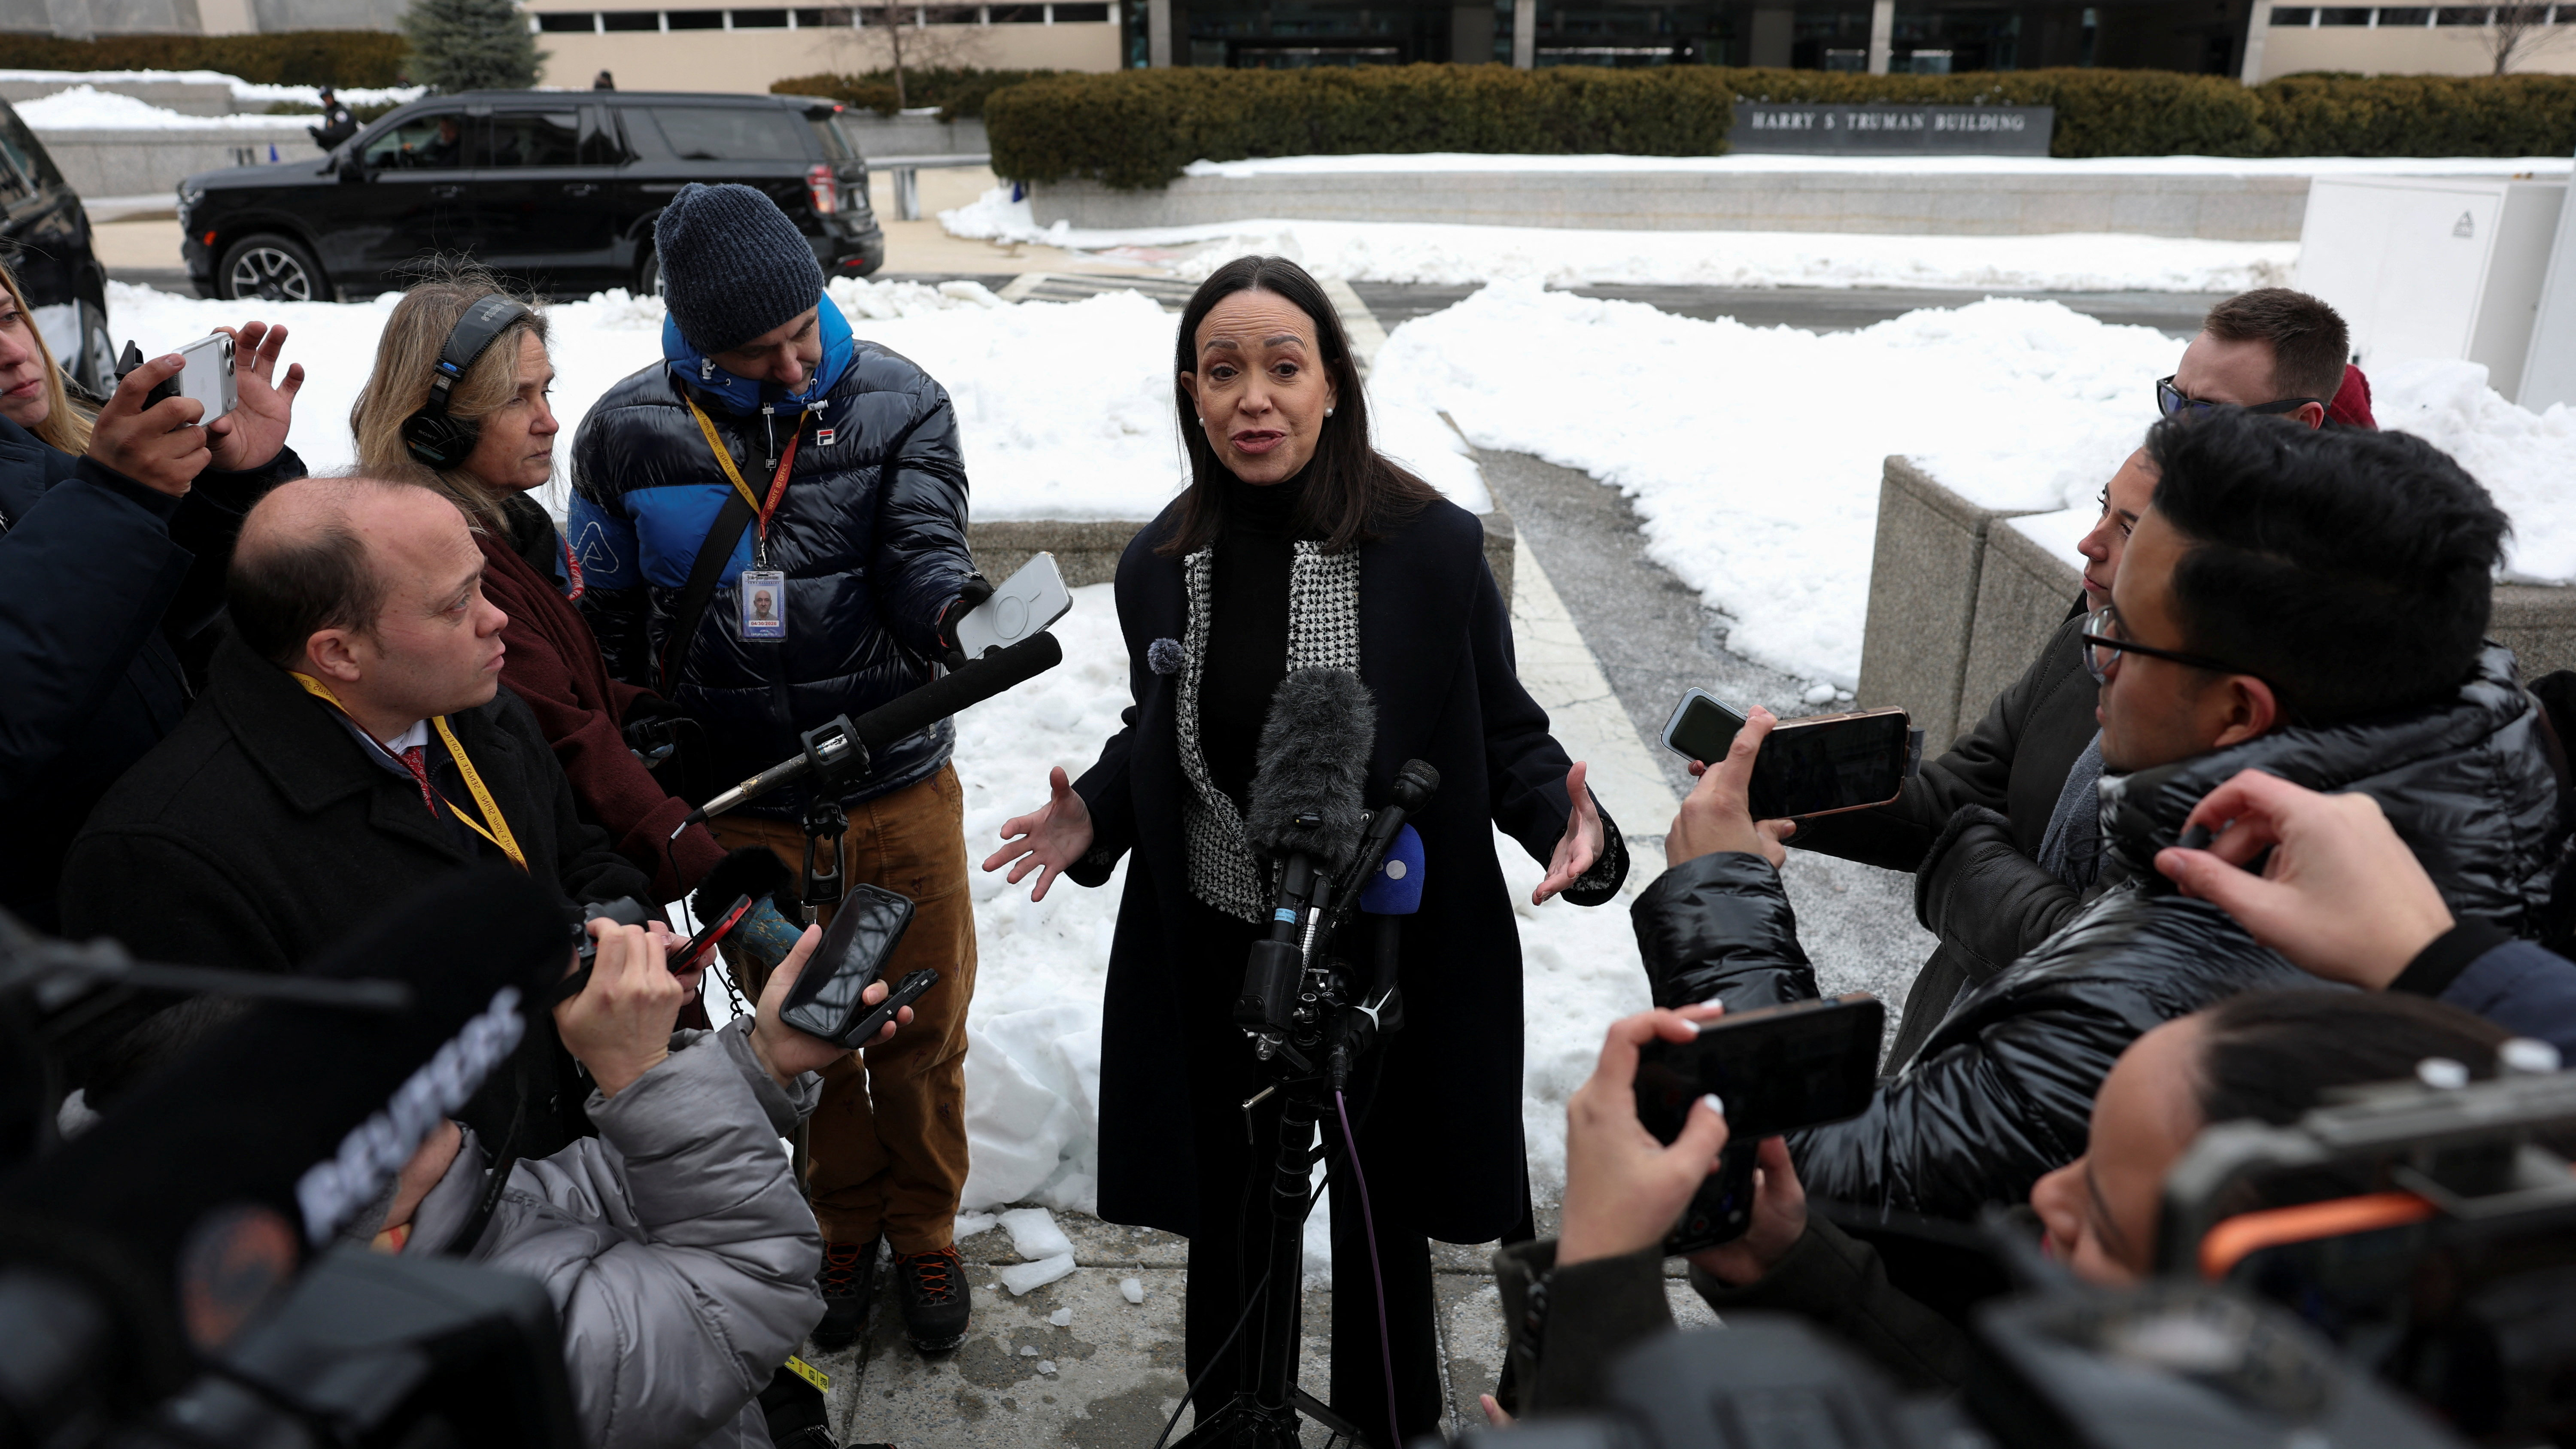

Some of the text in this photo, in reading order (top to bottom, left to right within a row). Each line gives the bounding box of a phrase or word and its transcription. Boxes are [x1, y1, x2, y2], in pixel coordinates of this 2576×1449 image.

[1752, 112, 2025, 131] HARRY S TRUMAN BUILDING
[481, 304, 504, 322] STUDIO
[418, 429, 437, 440] SONY
[767, 489, 779, 510] SENATE
[778, 463, 788, 481] OFFICE
